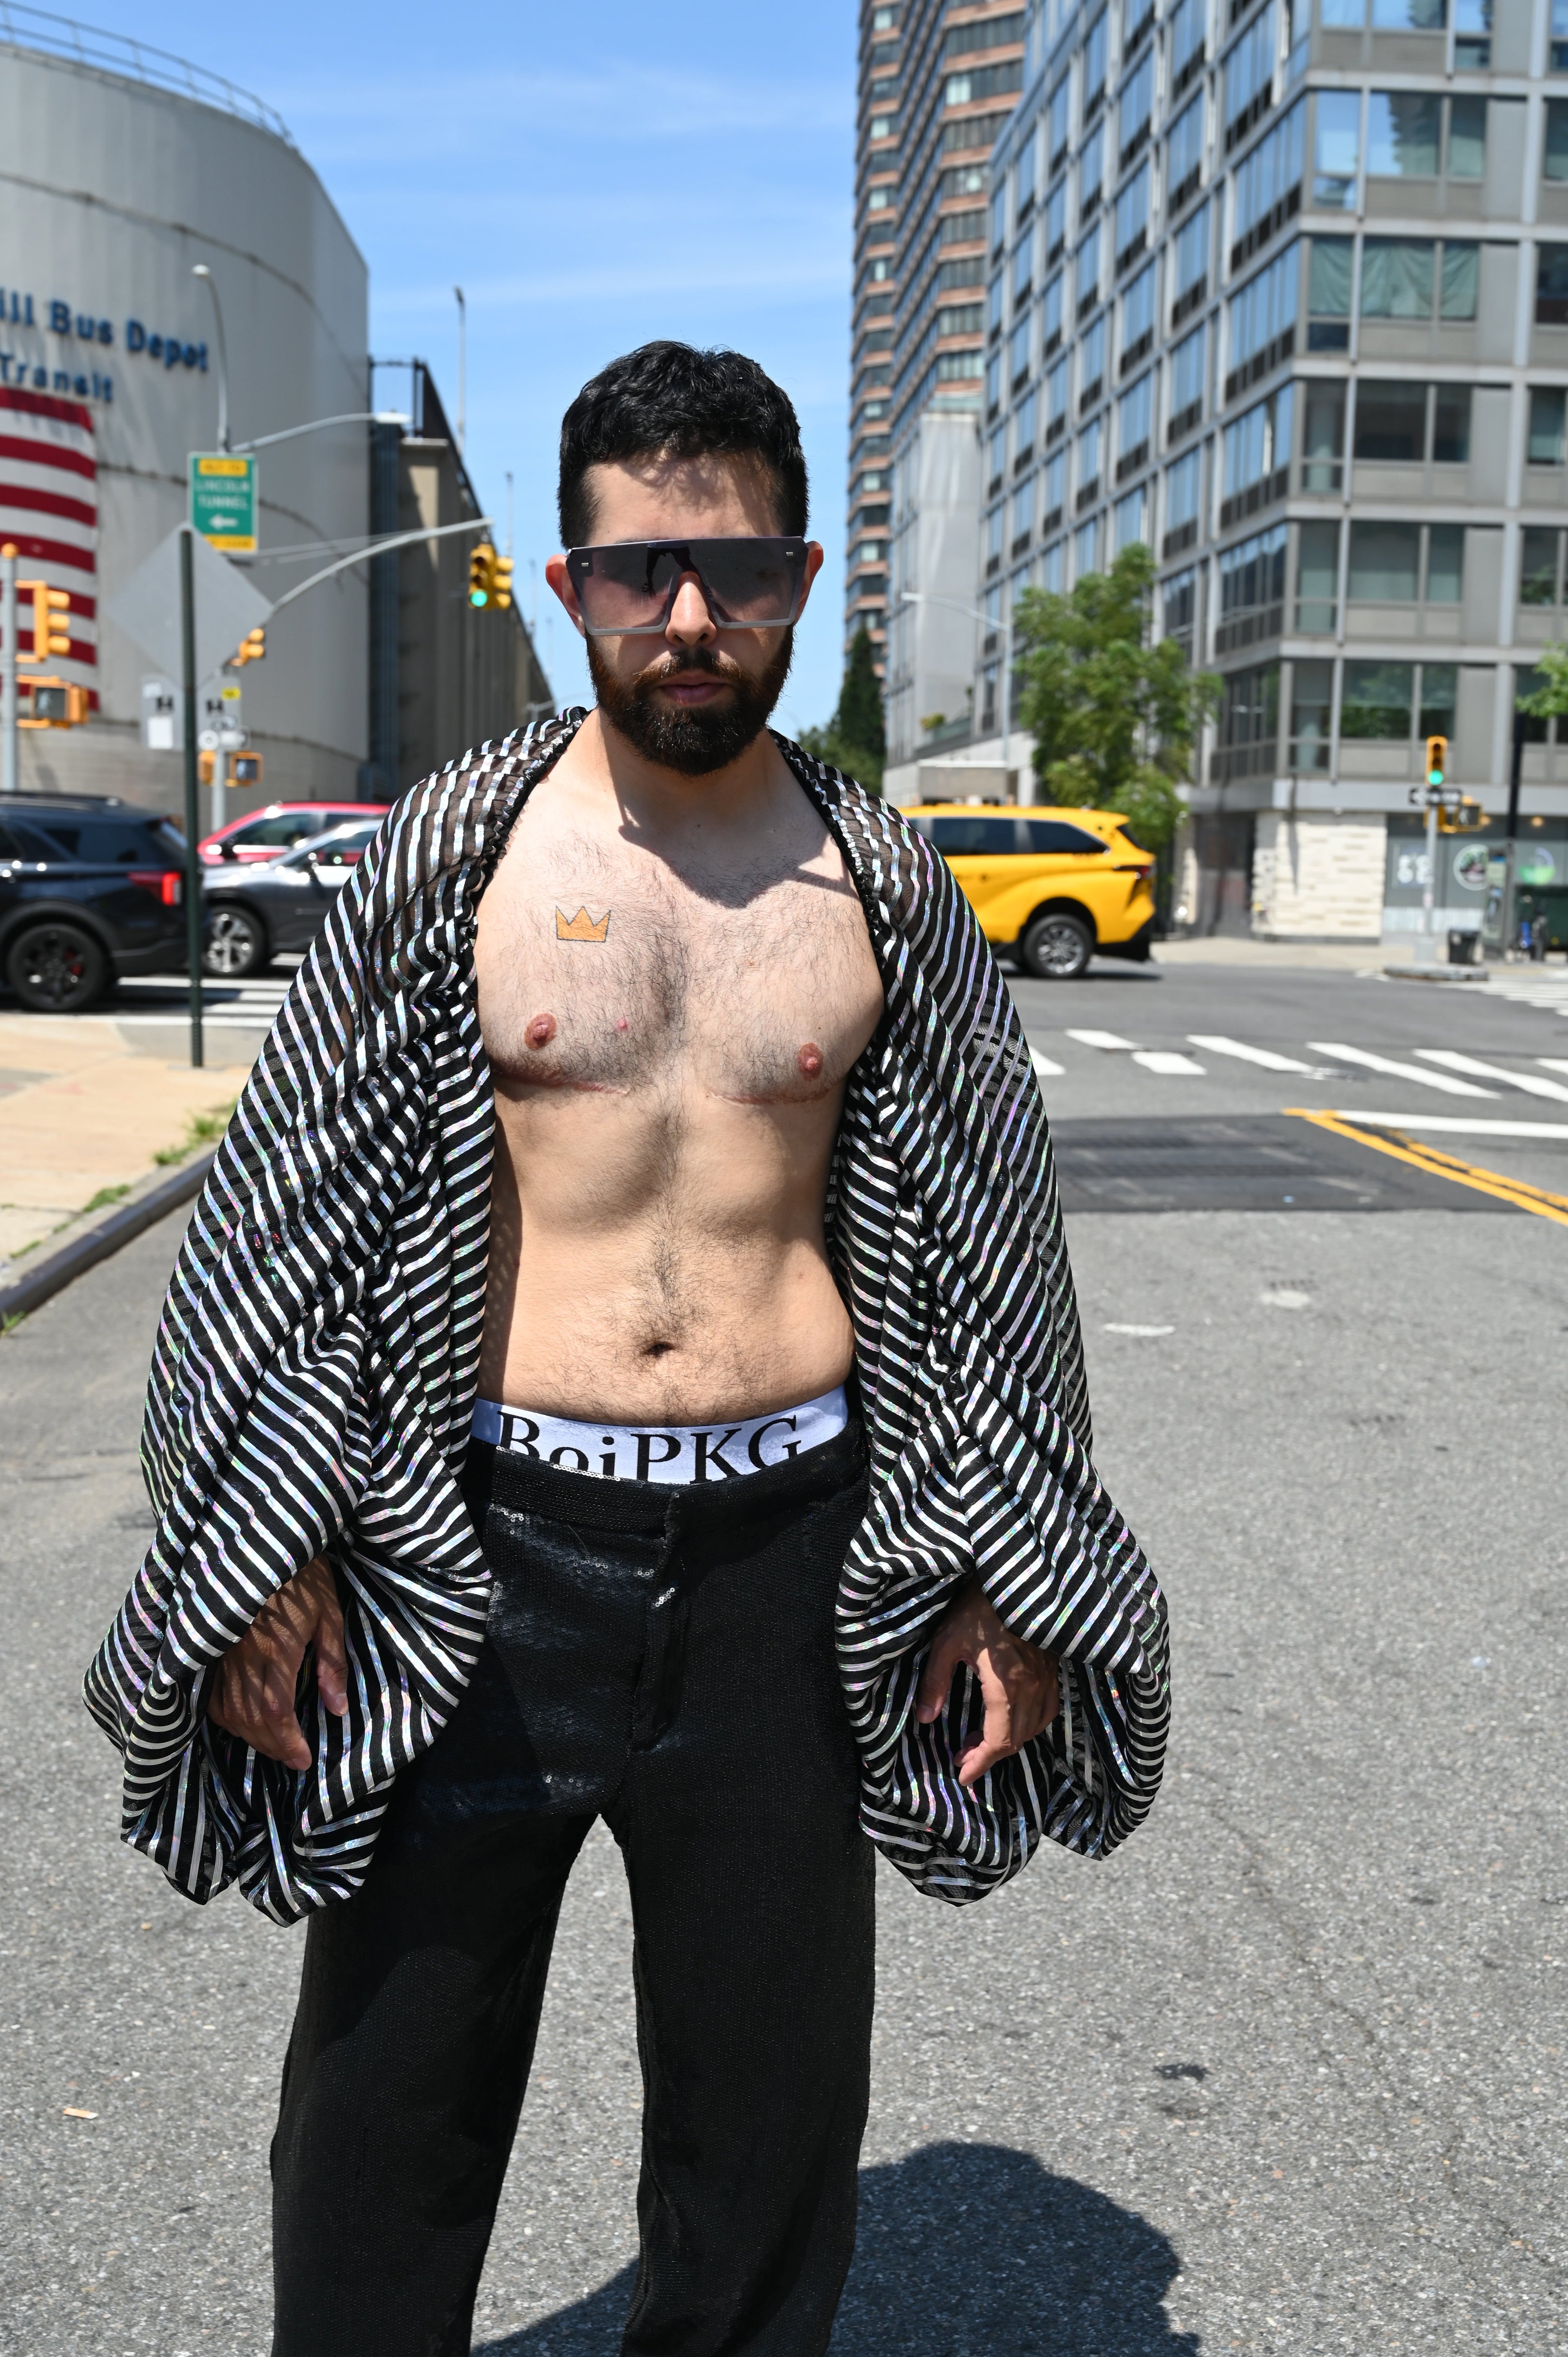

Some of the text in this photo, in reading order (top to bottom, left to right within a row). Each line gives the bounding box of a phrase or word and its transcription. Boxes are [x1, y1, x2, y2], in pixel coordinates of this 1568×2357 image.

[50, 299, 114, 345] Bus
[127, 318, 208, 374] Depot
[0, 354, 113, 403] Transit
